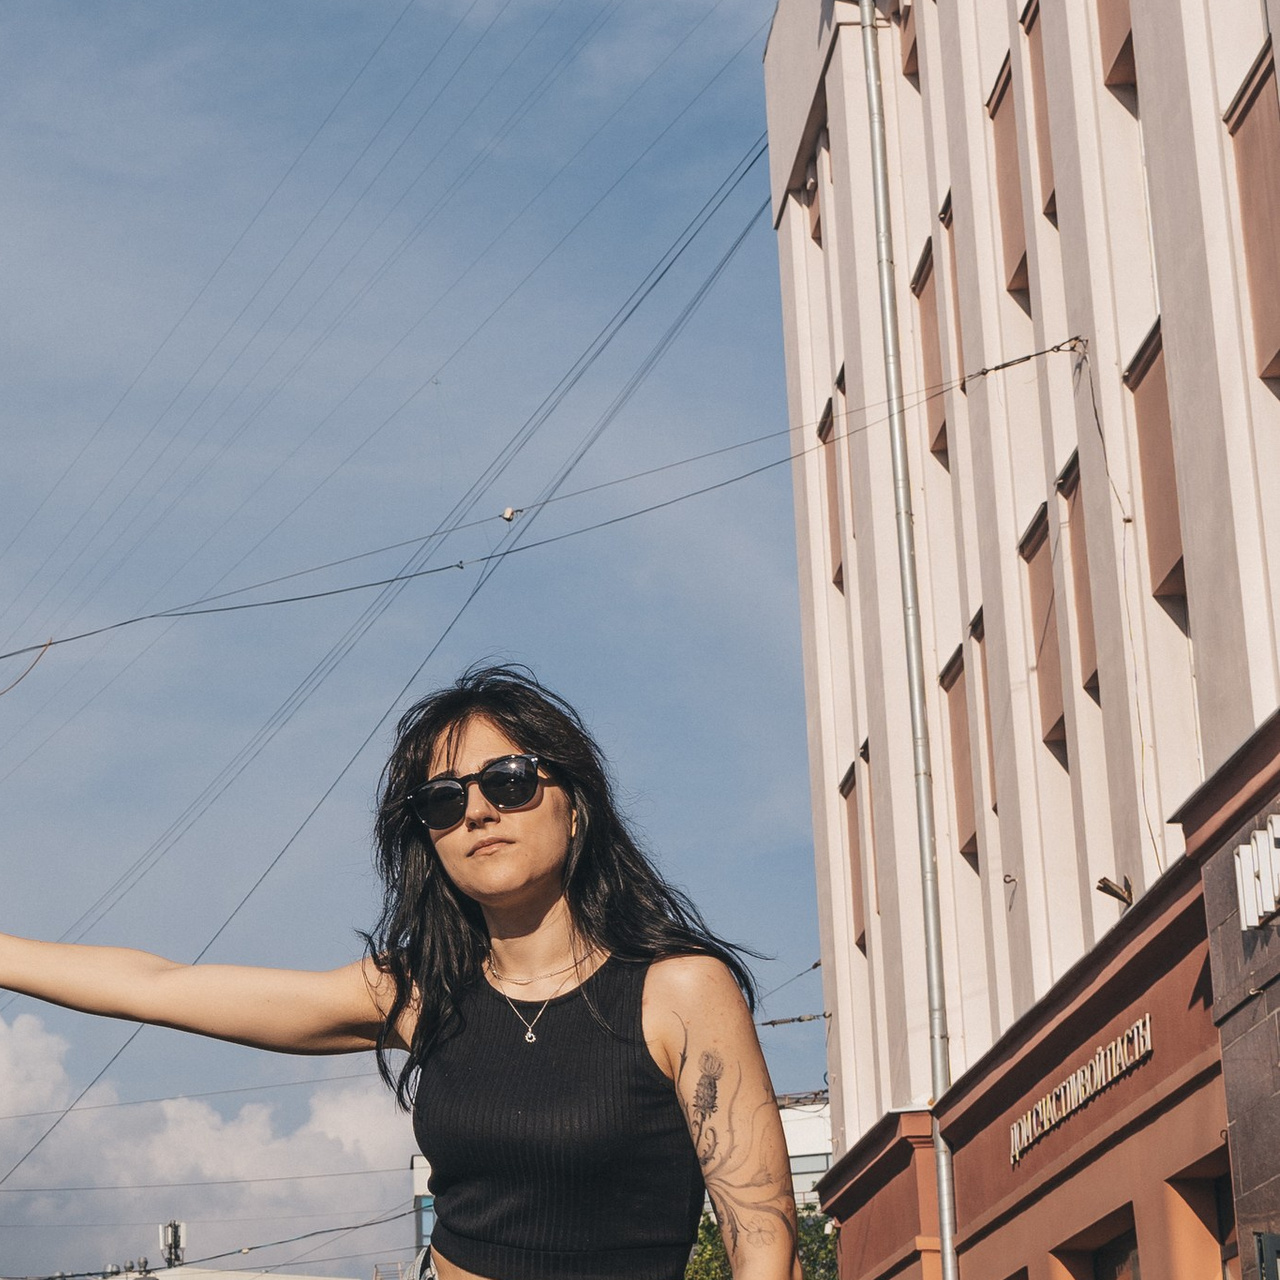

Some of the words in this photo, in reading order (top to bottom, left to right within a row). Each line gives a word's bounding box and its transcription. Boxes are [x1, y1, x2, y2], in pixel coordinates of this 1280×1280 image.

[1010, 1111, 1033, 1164] ДОМ
[1032, 1046, 1106, 1139] СЧАСТЛИВОЙ
[1106, 1013, 1152, 1082] ПАСТЫ
